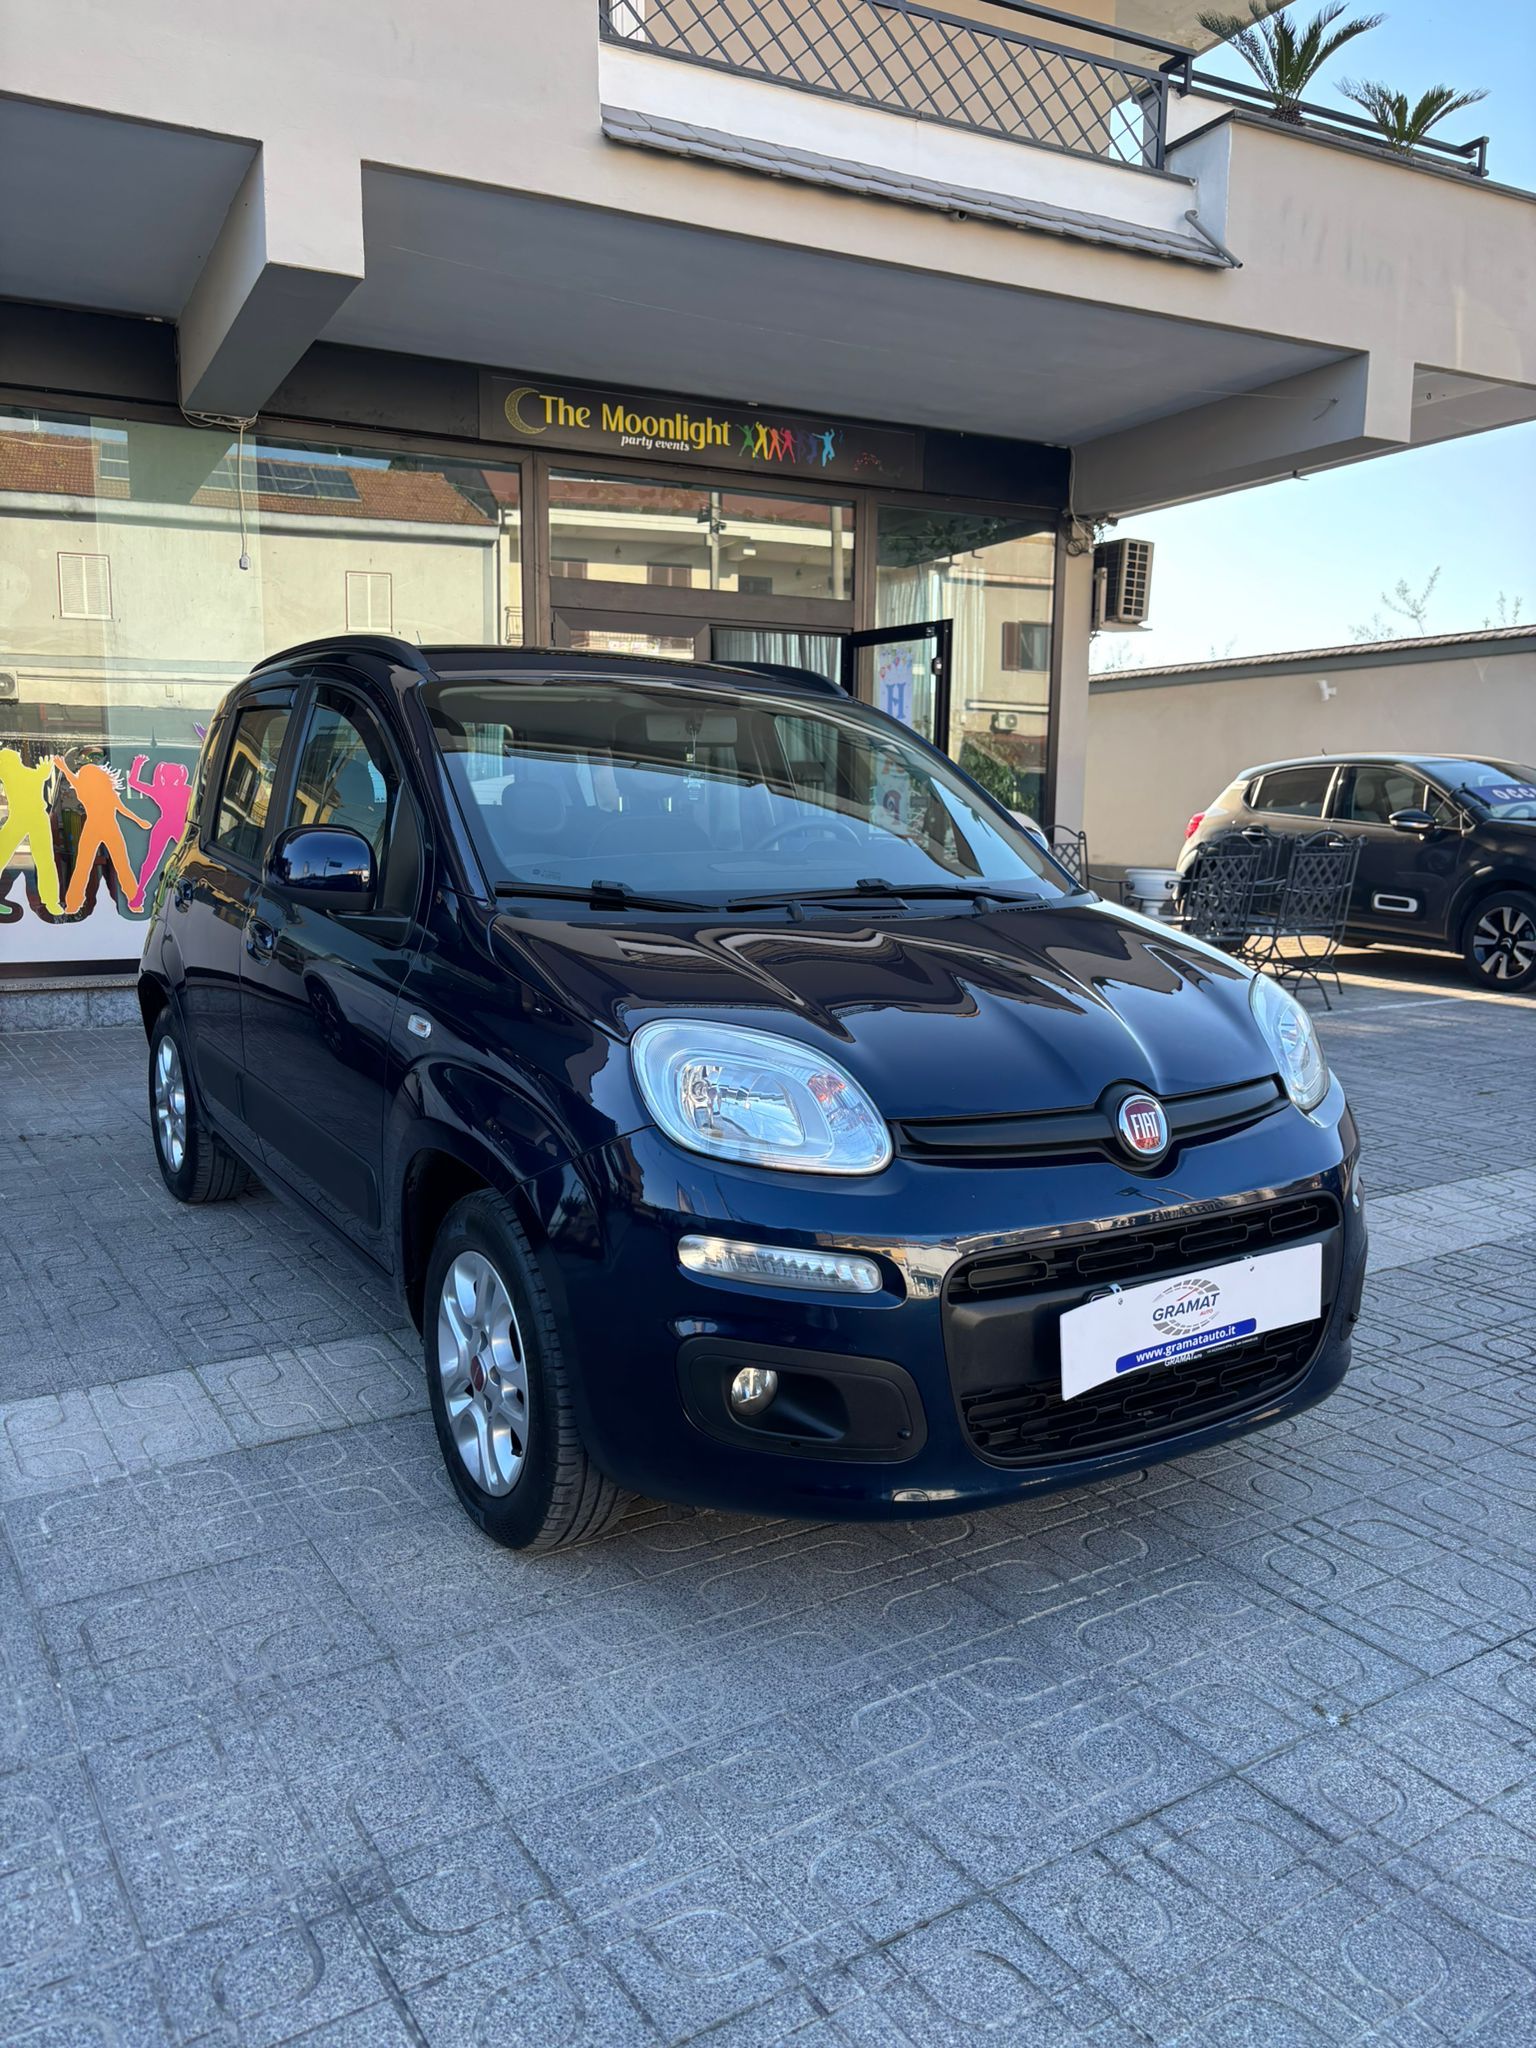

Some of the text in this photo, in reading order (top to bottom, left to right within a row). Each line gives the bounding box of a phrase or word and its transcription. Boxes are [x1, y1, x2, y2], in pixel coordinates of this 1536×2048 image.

[539, 394, 732, 450] The Moonlight
[620, 435, 690, 451] party events
[1130, 1111, 1160, 1140] FIAT
[1152, 1292, 1220, 1322] GRAMAT
[1135, 1325, 1236, 1362] www.gramatauto.it
